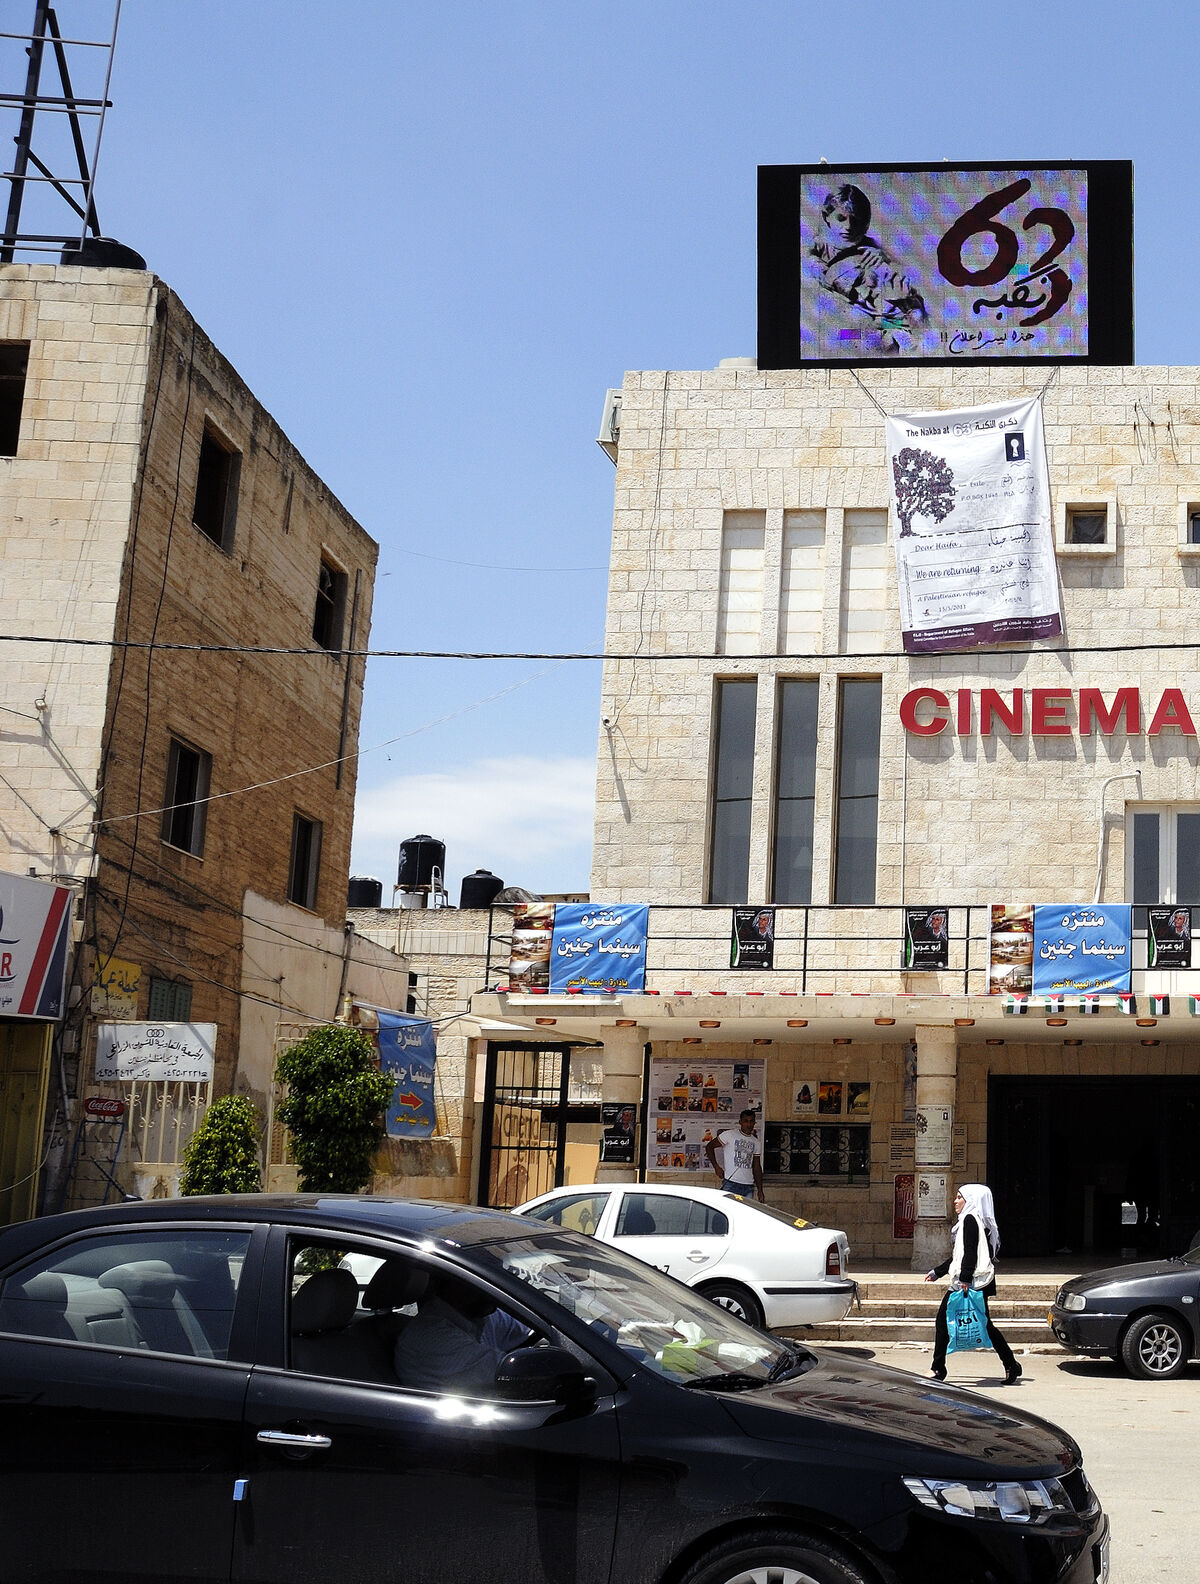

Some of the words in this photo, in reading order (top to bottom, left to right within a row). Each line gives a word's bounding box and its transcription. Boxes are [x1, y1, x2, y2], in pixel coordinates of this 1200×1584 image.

[937, 178, 1075, 326] 63
[906, 429, 919, 437] The
[920, 427, 941, 436] Nakba
[943, 426, 950, 434] at
[915, 570, 926, 579] We
[943, 565, 981, 576] returning
[899, 687, 1197, 736] CINEMA
[580, 911, 622, 930] منتزه
[1061, 911, 1105, 931] منتزه
[557, 937, 594, 957] جنين
[597, 938, 641, 958] سينما
[1040, 939, 1077, 960] جنين
[1081, 939, 1126, 960] سينما
